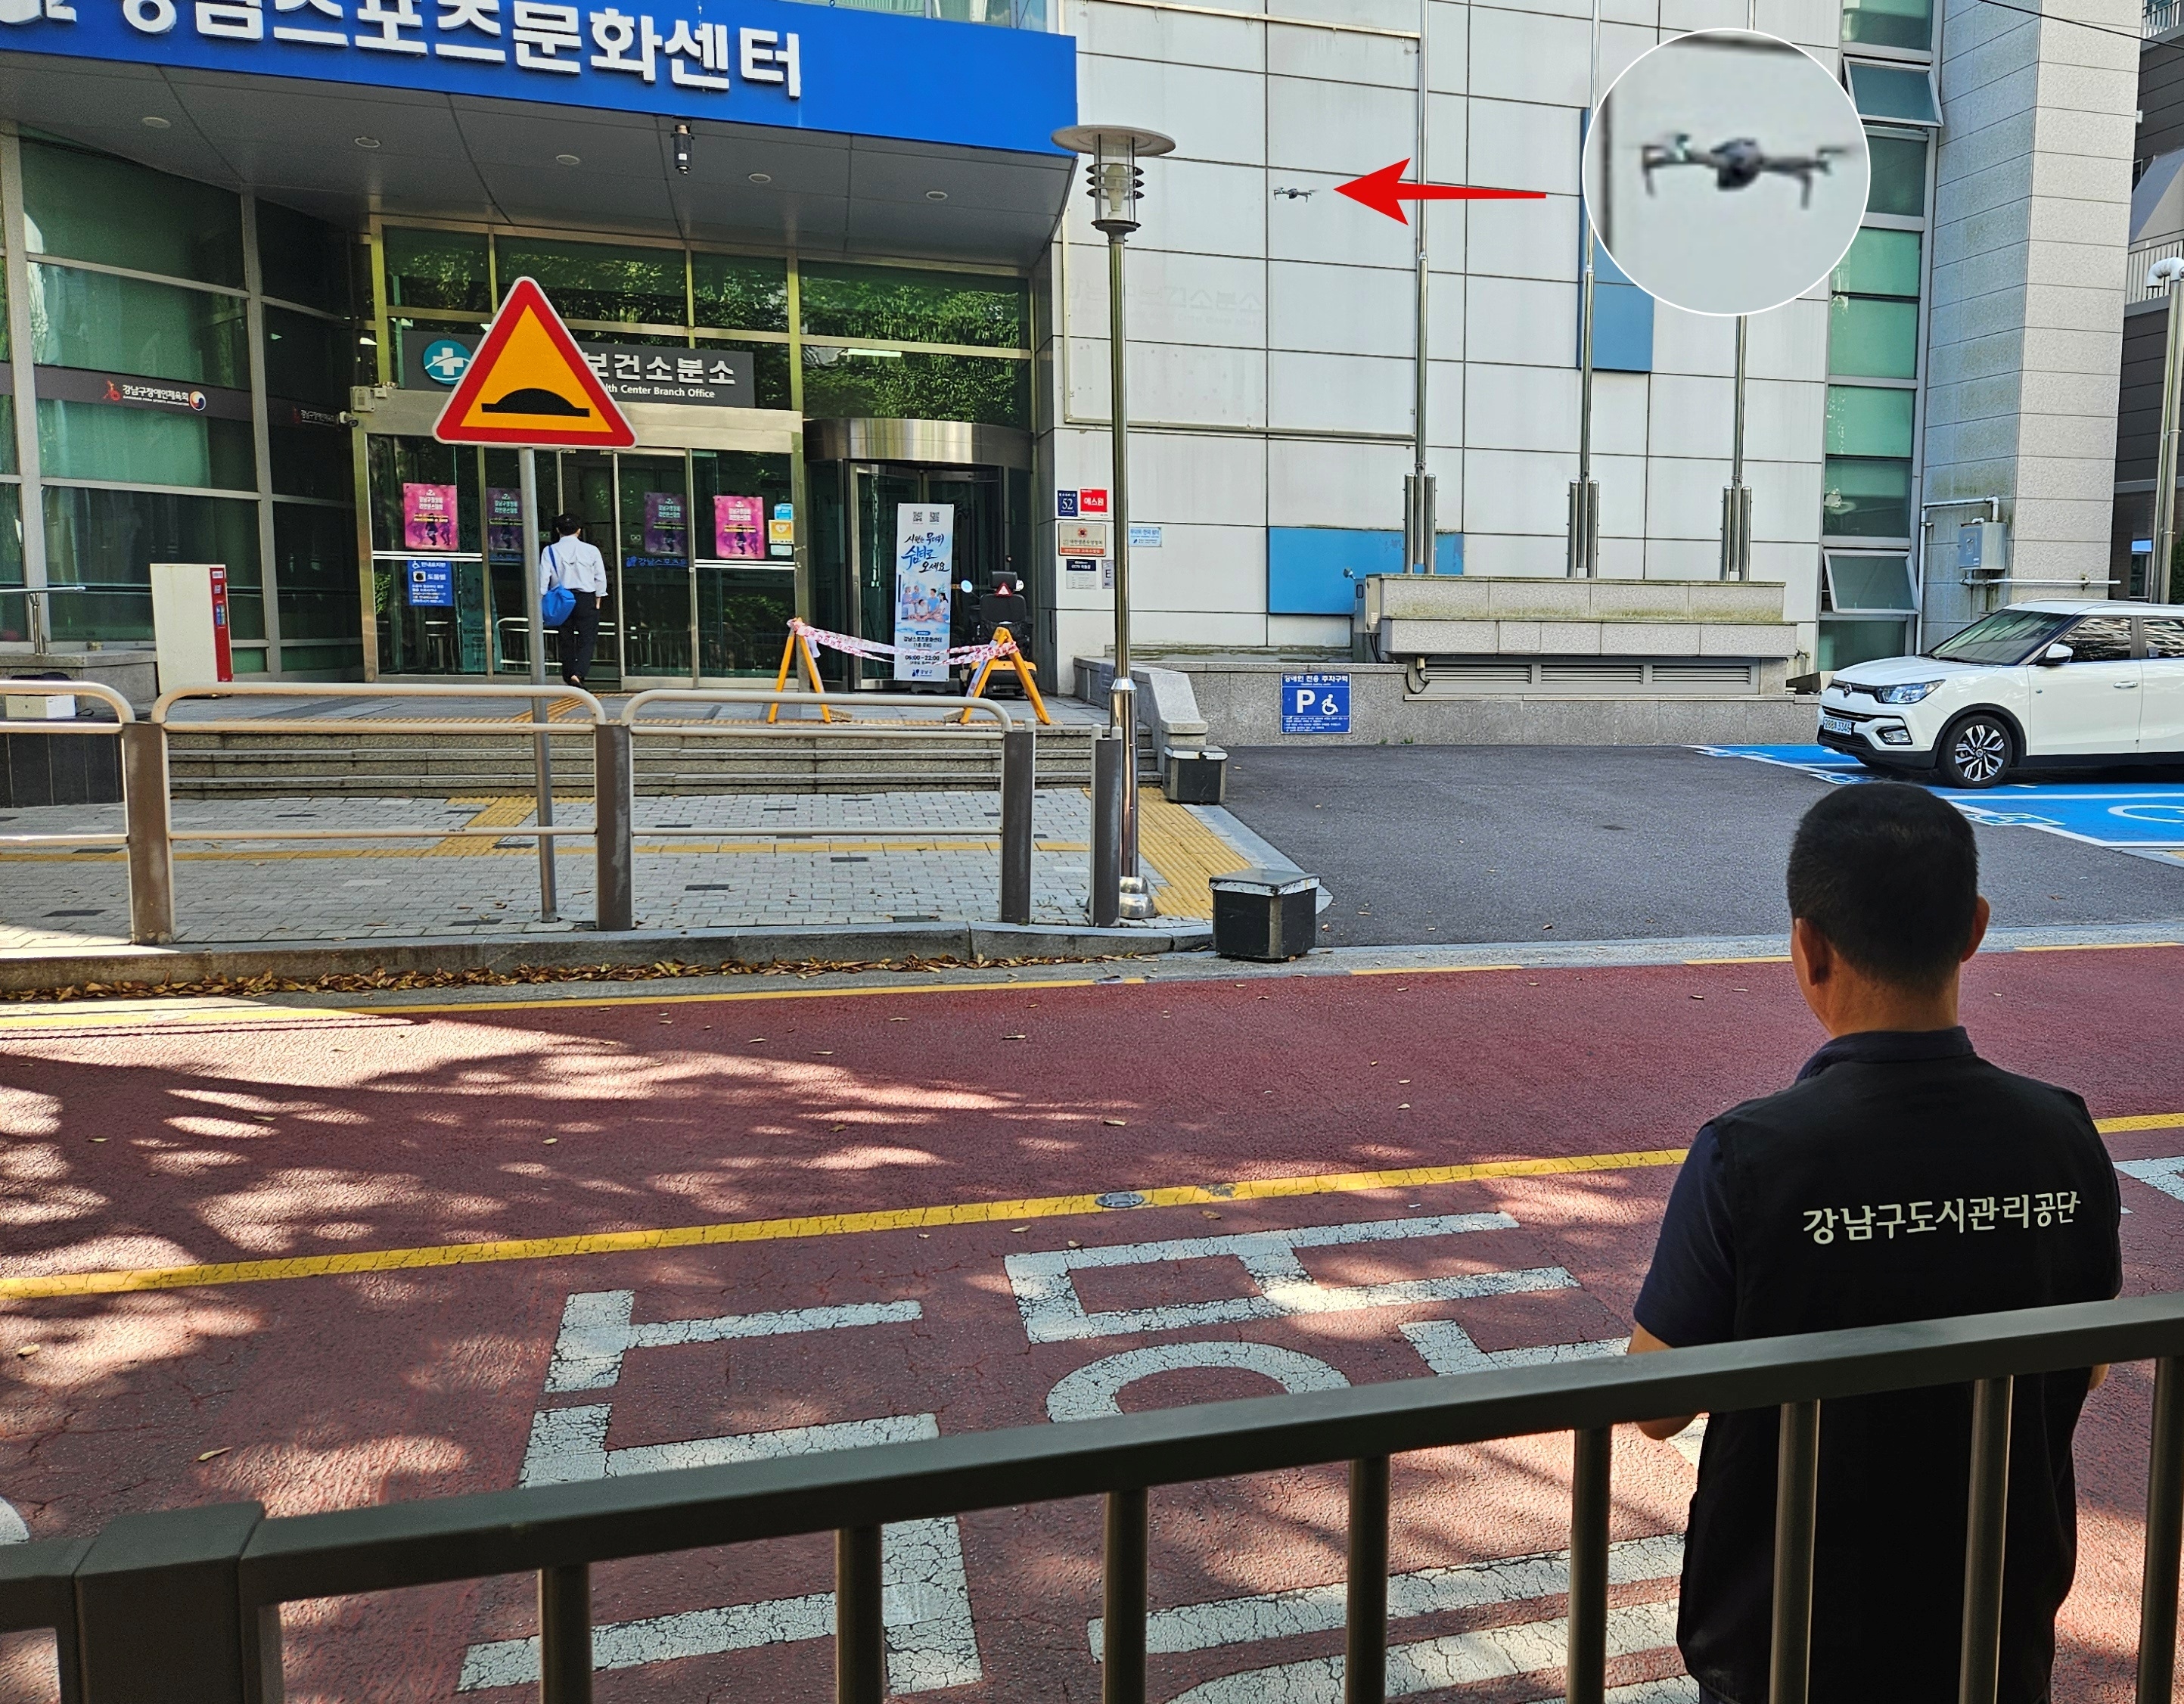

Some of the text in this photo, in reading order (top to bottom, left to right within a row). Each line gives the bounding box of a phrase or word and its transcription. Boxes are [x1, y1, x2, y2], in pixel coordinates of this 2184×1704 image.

[122, 0, 801, 98] 스포츠문화센터
[123, 384, 188, 402] 강남구장애인체육회
[620, 384, 652, 395] Center
[653, 386, 685, 398] Branch
[687, 388, 716, 399] Office
[1061, 498, 1074, 510] 52
[1083, 497, 1104, 506] 에스원
[918, 561, 951, 574] 오세요
[1297, 689, 1316, 714] P
[1803, 1190, 2082, 1245] 강남구도시관리공단
